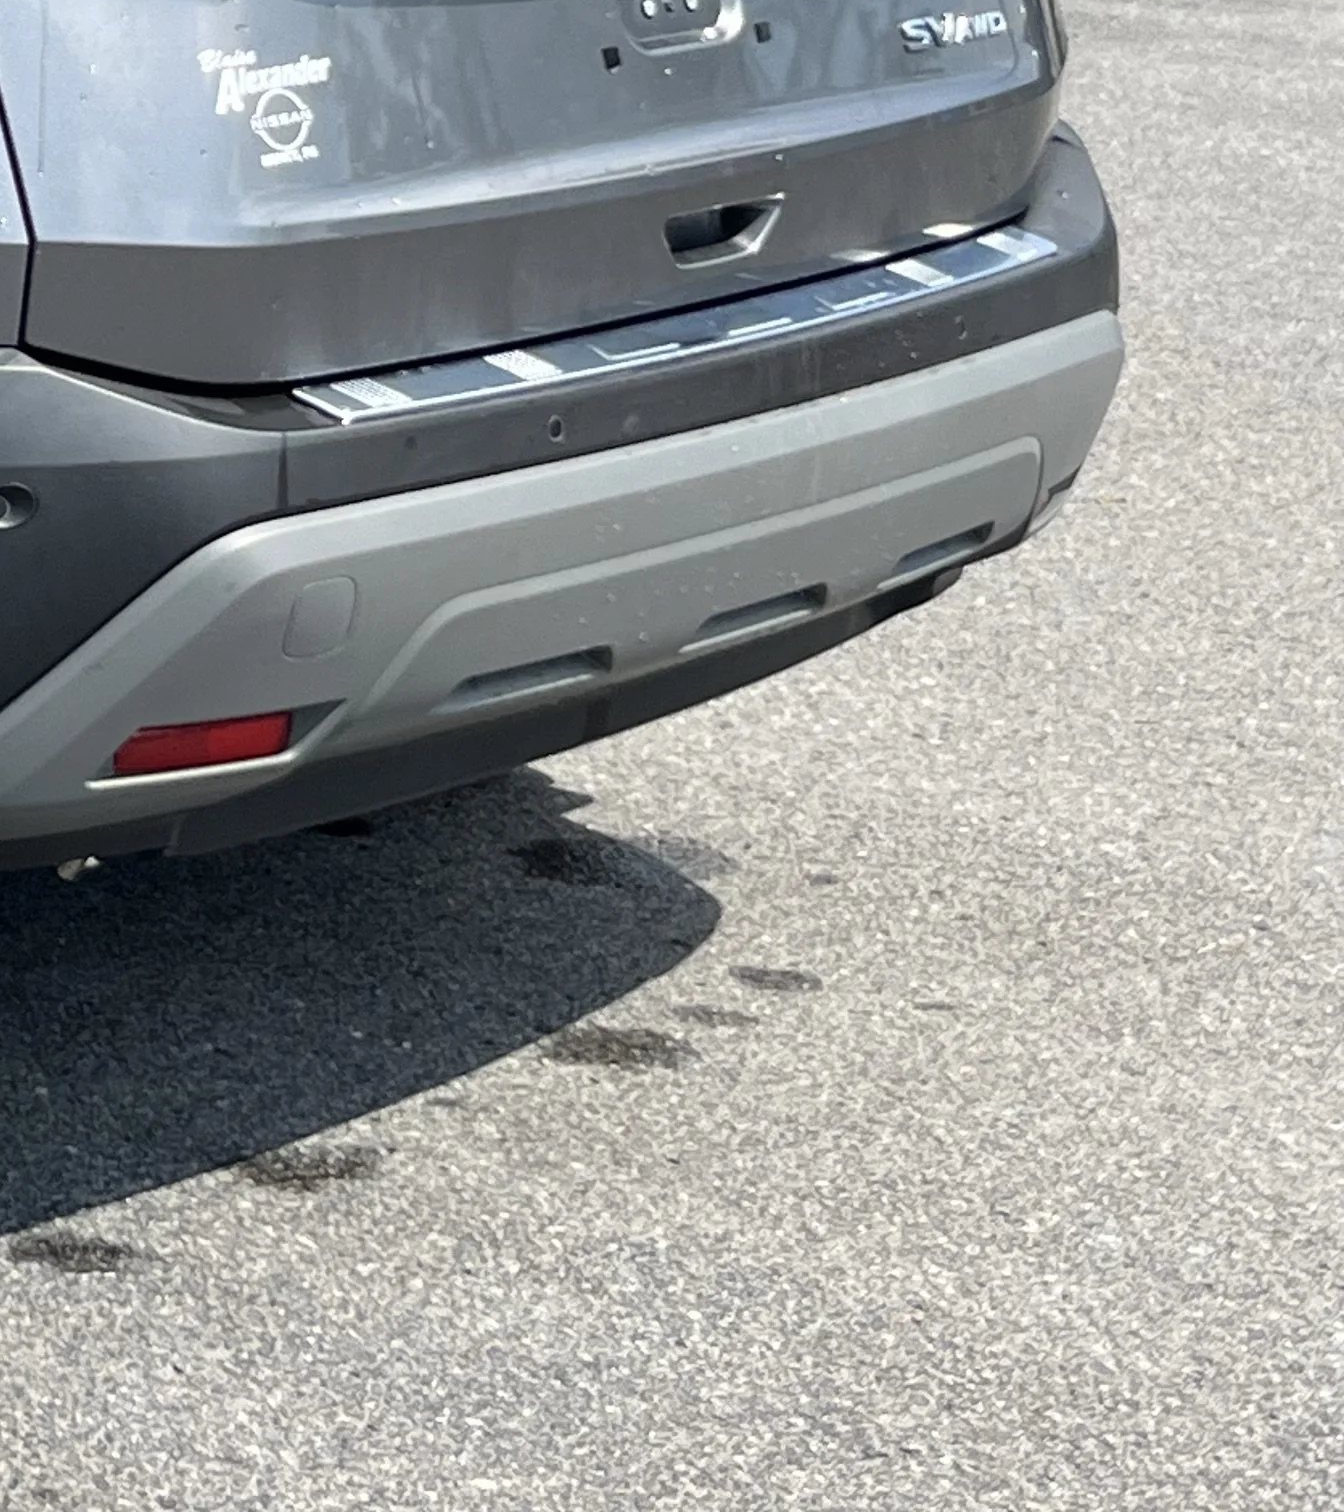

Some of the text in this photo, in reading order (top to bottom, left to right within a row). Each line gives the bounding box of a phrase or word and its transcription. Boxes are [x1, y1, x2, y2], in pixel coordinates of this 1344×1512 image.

[900, 12, 953, 50] SV
[215, 55, 331, 114] Alexander
[251, 109, 313, 132] NISSAN
